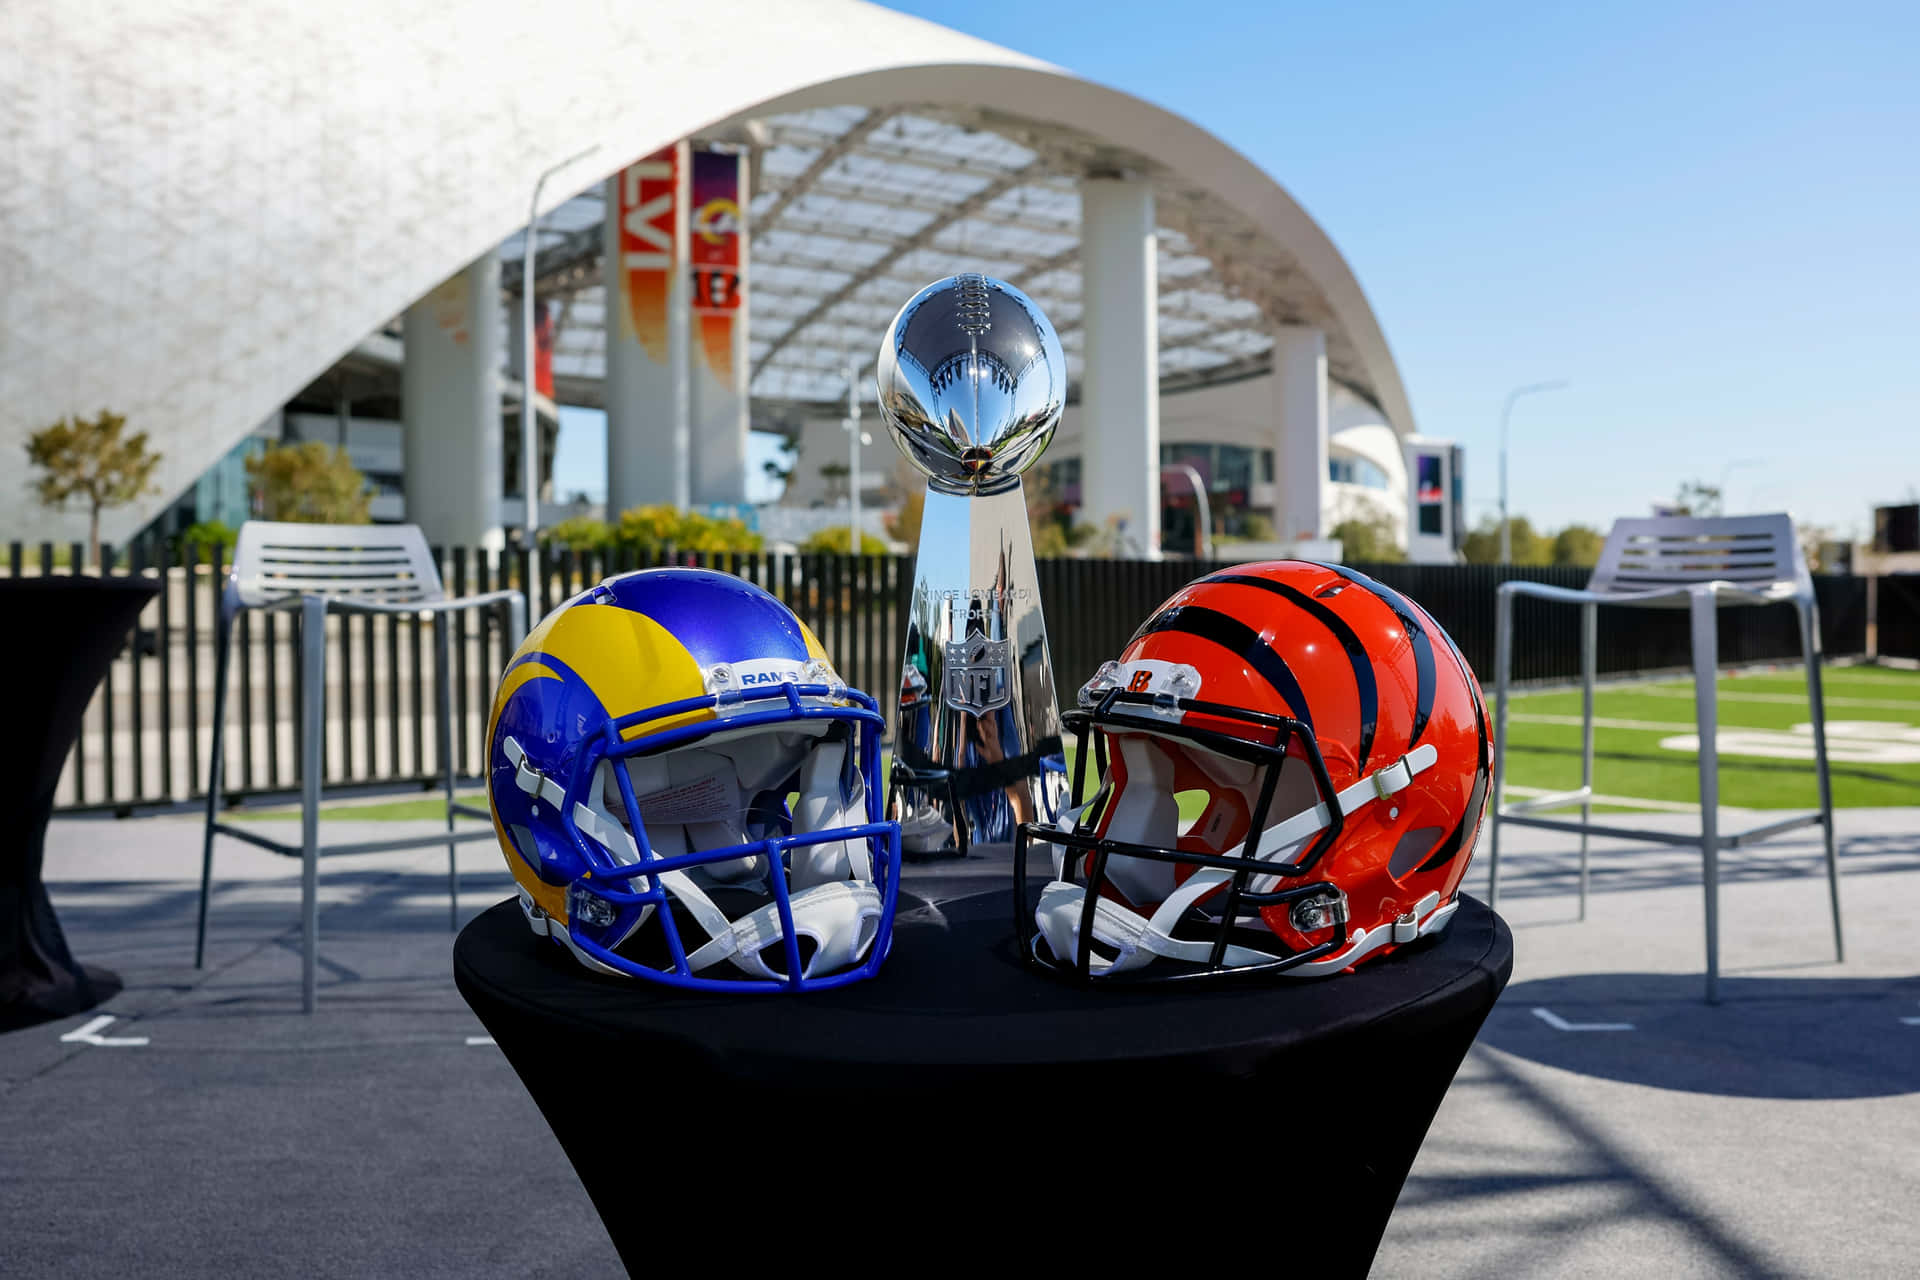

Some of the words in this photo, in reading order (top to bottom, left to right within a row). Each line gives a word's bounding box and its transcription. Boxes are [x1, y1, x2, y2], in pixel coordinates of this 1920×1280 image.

[625, 162, 672, 269] LVI
[950, 608, 1001, 620] TROPH
[741, 671, 799, 685] RAMS
[950, 669, 1005, 708] NFL
[1128, 670, 1152, 693] B
